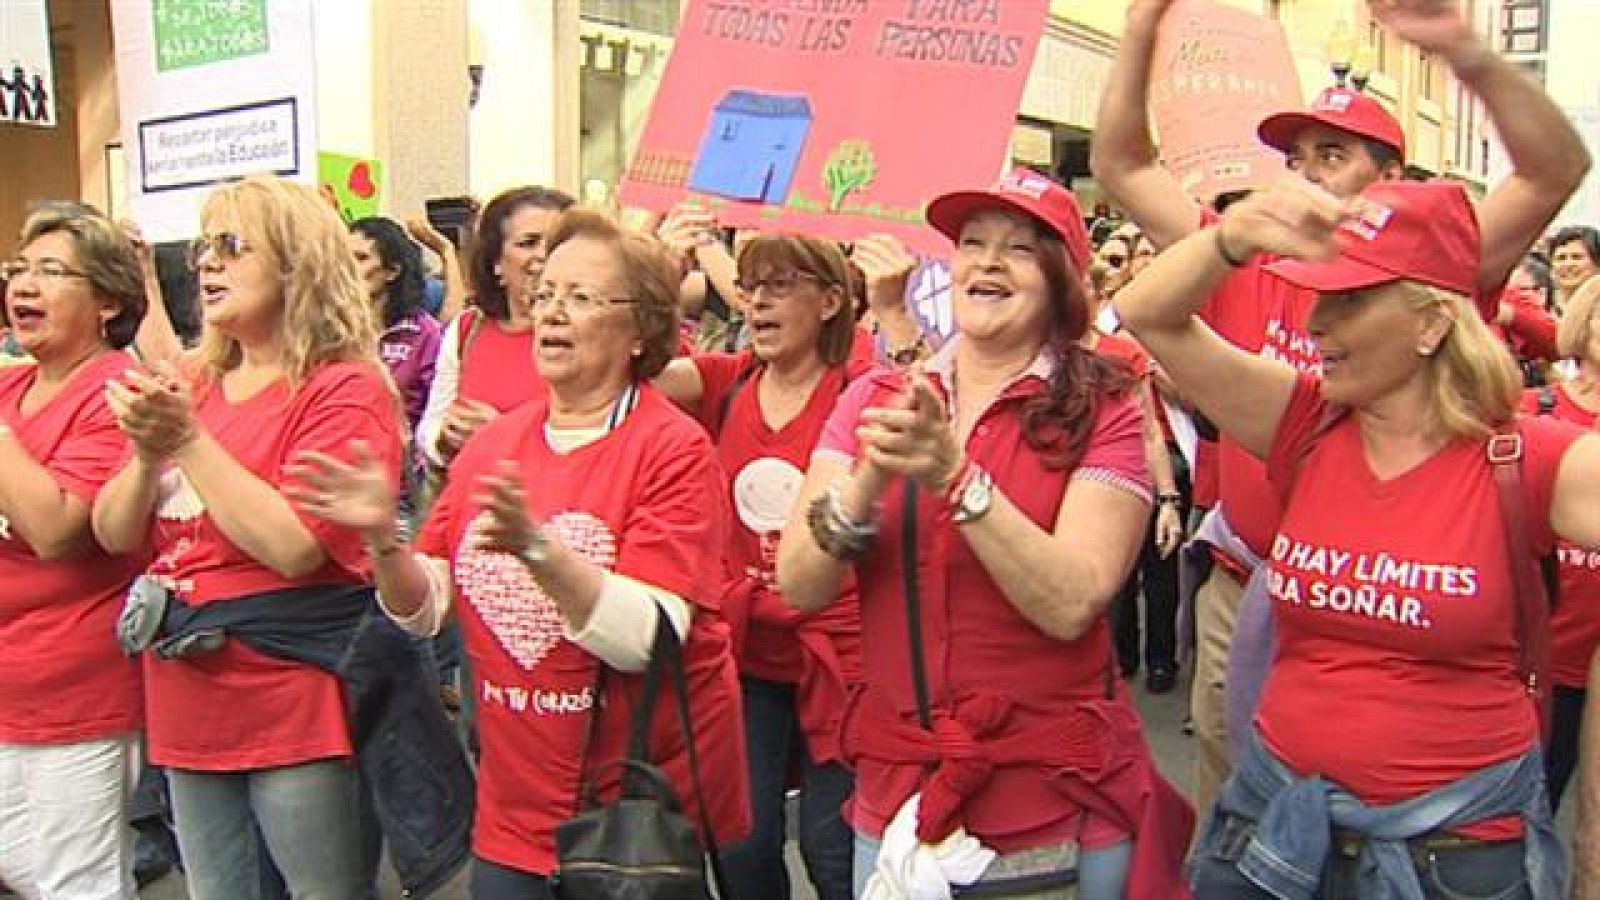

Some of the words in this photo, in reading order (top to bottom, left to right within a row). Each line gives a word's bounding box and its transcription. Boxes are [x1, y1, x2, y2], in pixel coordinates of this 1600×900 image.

[704, 4, 788, 46] TODAS
[799, 17, 852, 51] LAS
[876, 20, 1023, 67] PERSONAS
[1287, 540, 1353, 577] HAY
[1353, 550, 1478, 597] LÍMITES
[1308, 579, 1431, 629] SOÑAR.
